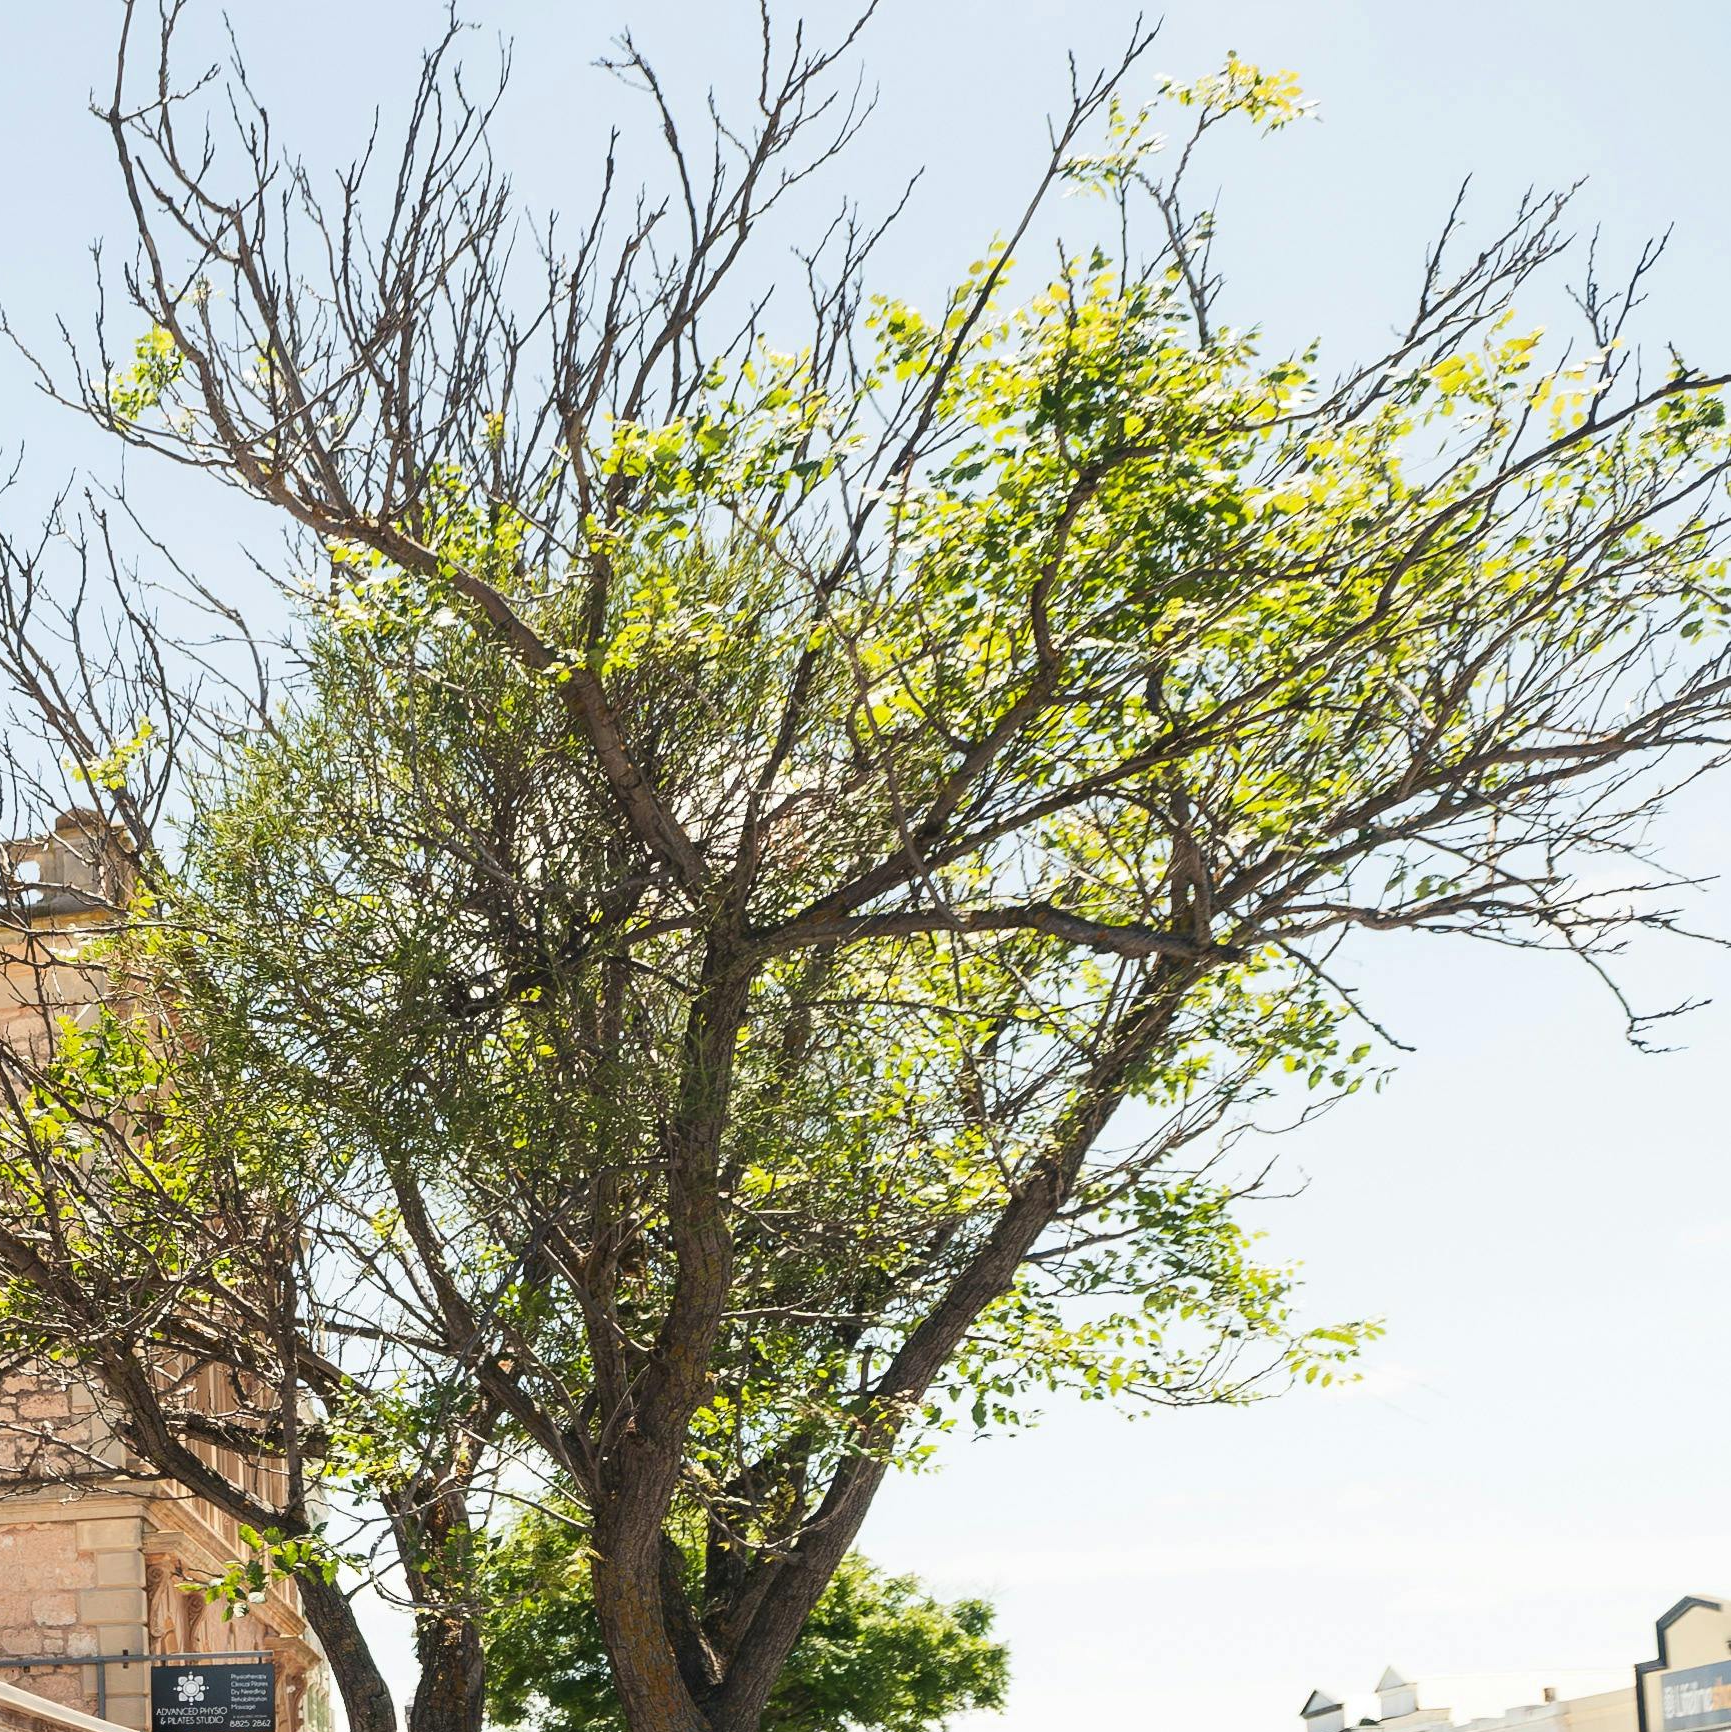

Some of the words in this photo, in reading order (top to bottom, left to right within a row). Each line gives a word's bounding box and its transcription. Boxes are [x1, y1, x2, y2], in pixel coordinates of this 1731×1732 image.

[156, 1707, 198, 1716] ADVANCED
[199, 1706, 228, 1715] PHYSIO
[160, 1717, 166, 1725] &
[167, 1716, 195, 1725] PILATES
[196, 1715, 224, 1724] STUDIO
